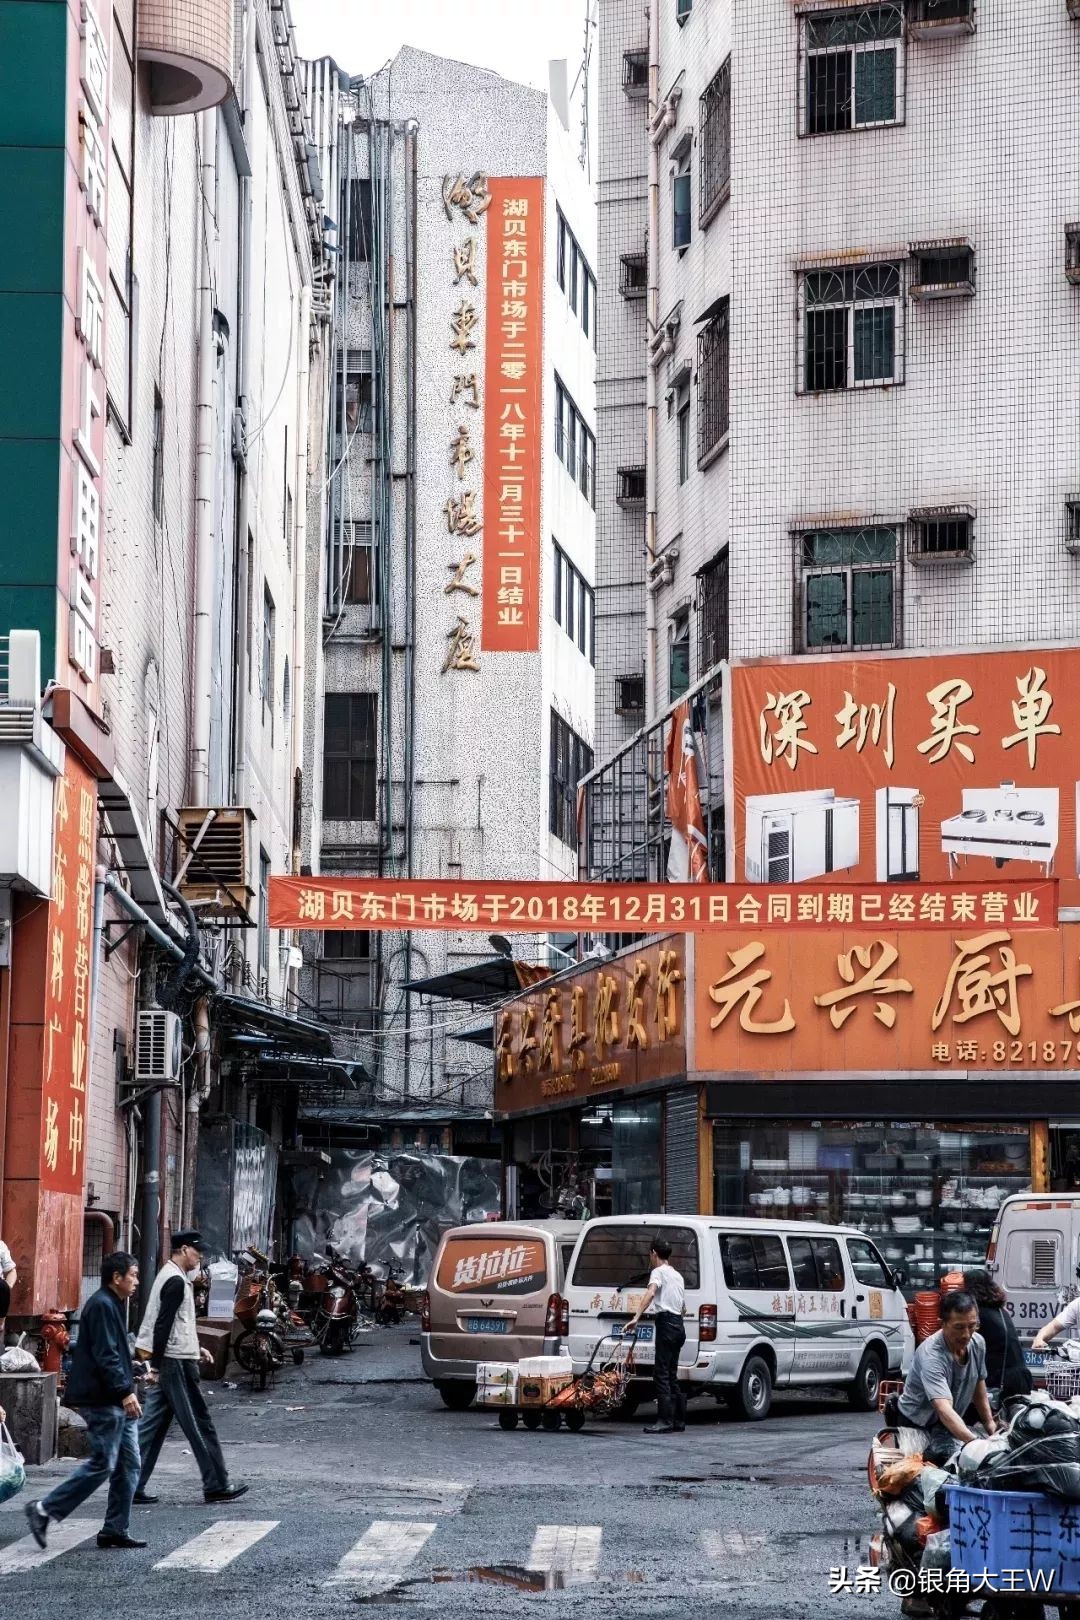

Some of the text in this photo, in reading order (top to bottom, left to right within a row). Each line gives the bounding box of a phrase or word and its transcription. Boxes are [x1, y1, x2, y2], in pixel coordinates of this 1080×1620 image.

[497, 199, 528, 624] 湖贝东门市场于二零一八年十二月三十一日结业
[759, 666, 1062, 770] 深圳买单
[298, 890, 1039, 923] 湖贝东门市场于2018年12月31日合同到期已经结束营业
[69, 788, 92, 1176] 照常营业中
[708, 931, 1080, 1037] 元兴厨
[932, 1039, 1080, 1063] 电话:82187
[452, 1245, 530, 1287] 货拉拉
